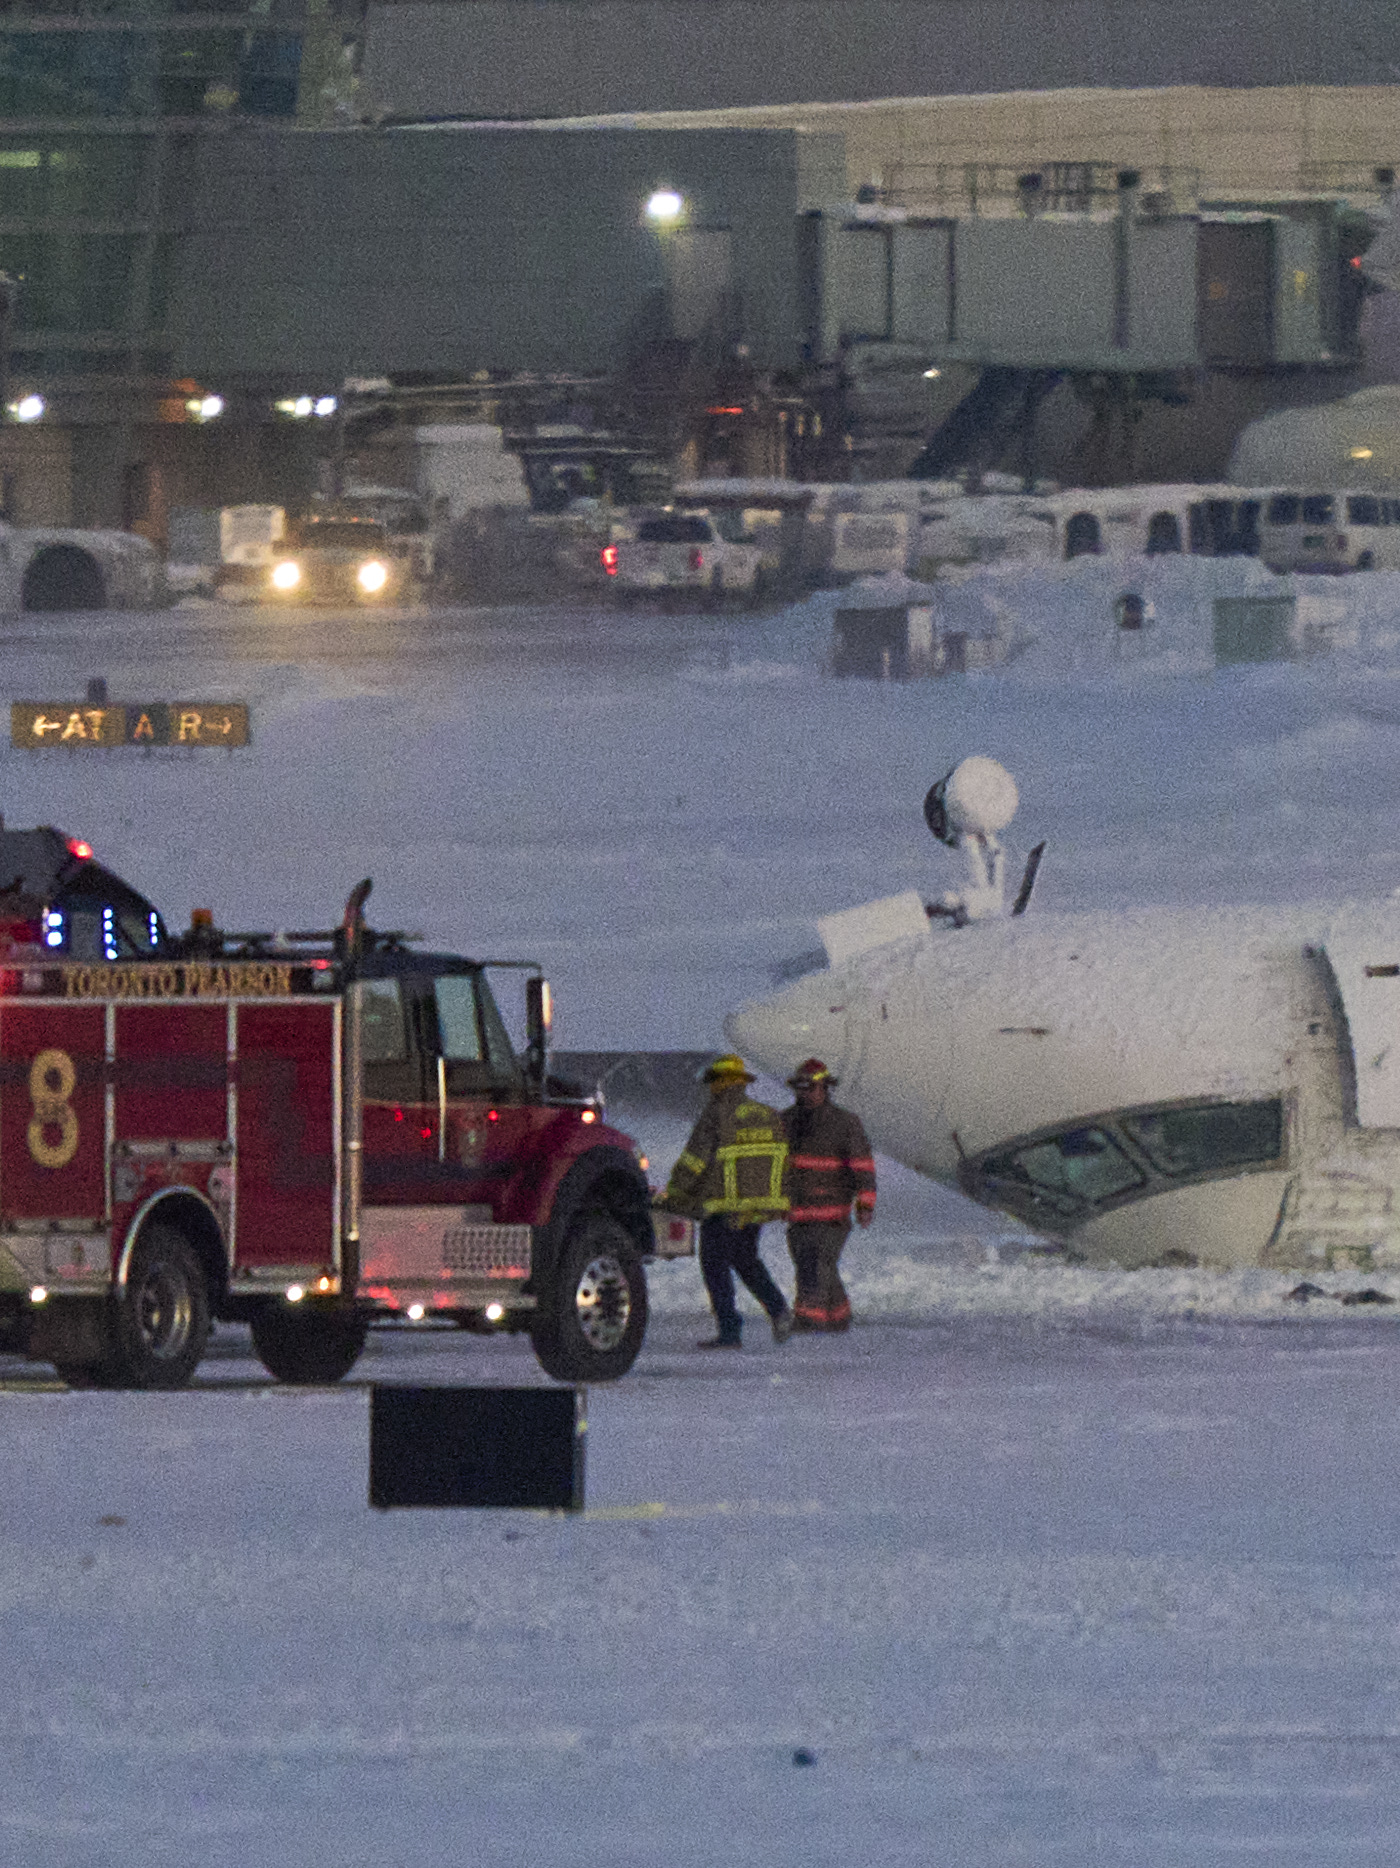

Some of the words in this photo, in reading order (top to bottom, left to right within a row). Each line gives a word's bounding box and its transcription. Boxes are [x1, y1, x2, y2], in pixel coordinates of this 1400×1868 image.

[133, 712, 154, 740] A
[179, 712, 202, 741] R
[63, 963, 174, 997] TORONTO
[182, 962, 291, 997] PEARSON
[27, 1048, 79, 1169] 8
